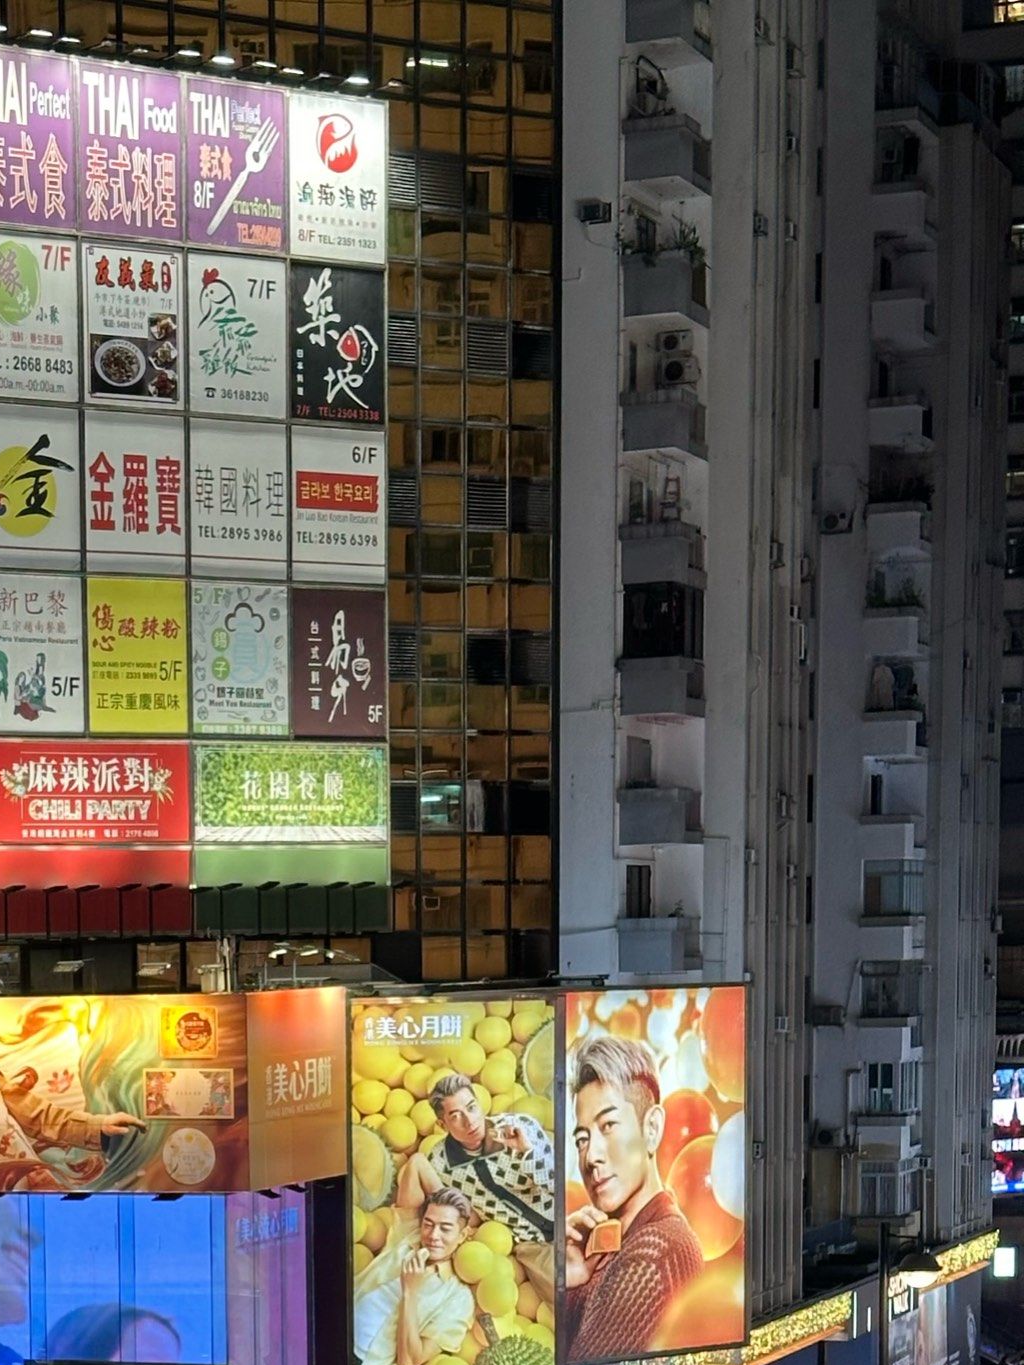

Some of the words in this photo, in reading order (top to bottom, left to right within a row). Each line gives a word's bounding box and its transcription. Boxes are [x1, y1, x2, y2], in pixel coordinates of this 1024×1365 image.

[29, 82, 71, 119] Perfect
[82, 71, 139, 140] THAI
[143, 98, 176, 134] Food
[190, 92, 230, 138] THAI
[231, 100, 261, 125] Perfect
[200, 143, 232, 181] 泰式食
[86, 140, 176, 227] 泰式料理
[194, 180, 214, 209] 8/F
[298, 229, 316, 242] 8/F
[337, 236, 355, 247] 2351
[359, 239, 376, 249] 1323
[42, 244, 71, 271] 7/F
[247, 278, 276, 300] 7/F
[161, 298, 173, 310] 7/F
[13, 355, 41, 372] 2668
[46, 358, 73, 375] 8483
[352, 446, 377, 464] 6/F
[89, 451, 181, 535] 金羅寶
[195, 464, 284, 518] 韓國料理
[334, 482, 373, 503] 한국요리
[254, 529, 283, 542] 3986
[350, 534, 378, 547] 6398
[92, 603, 116, 652] 傷心
[118, 616, 181, 640] 酸辣粉
[159, 660, 182, 681] 5/F
[51, 677, 80, 696] 5/F
[96, 693, 180, 710] 正宗重慶風味
[368, 705, 383, 722] 5F
[27, 756, 152, 793] 麻辣派對
[239, 769, 344, 800] 花園餐廳
[28, 799, 82, 820] CHILI
[86, 799, 151, 820] PARTY
[376, 1015, 461, 1039] 美心月餅
[274, 1056, 333, 1104] 美心月餅
